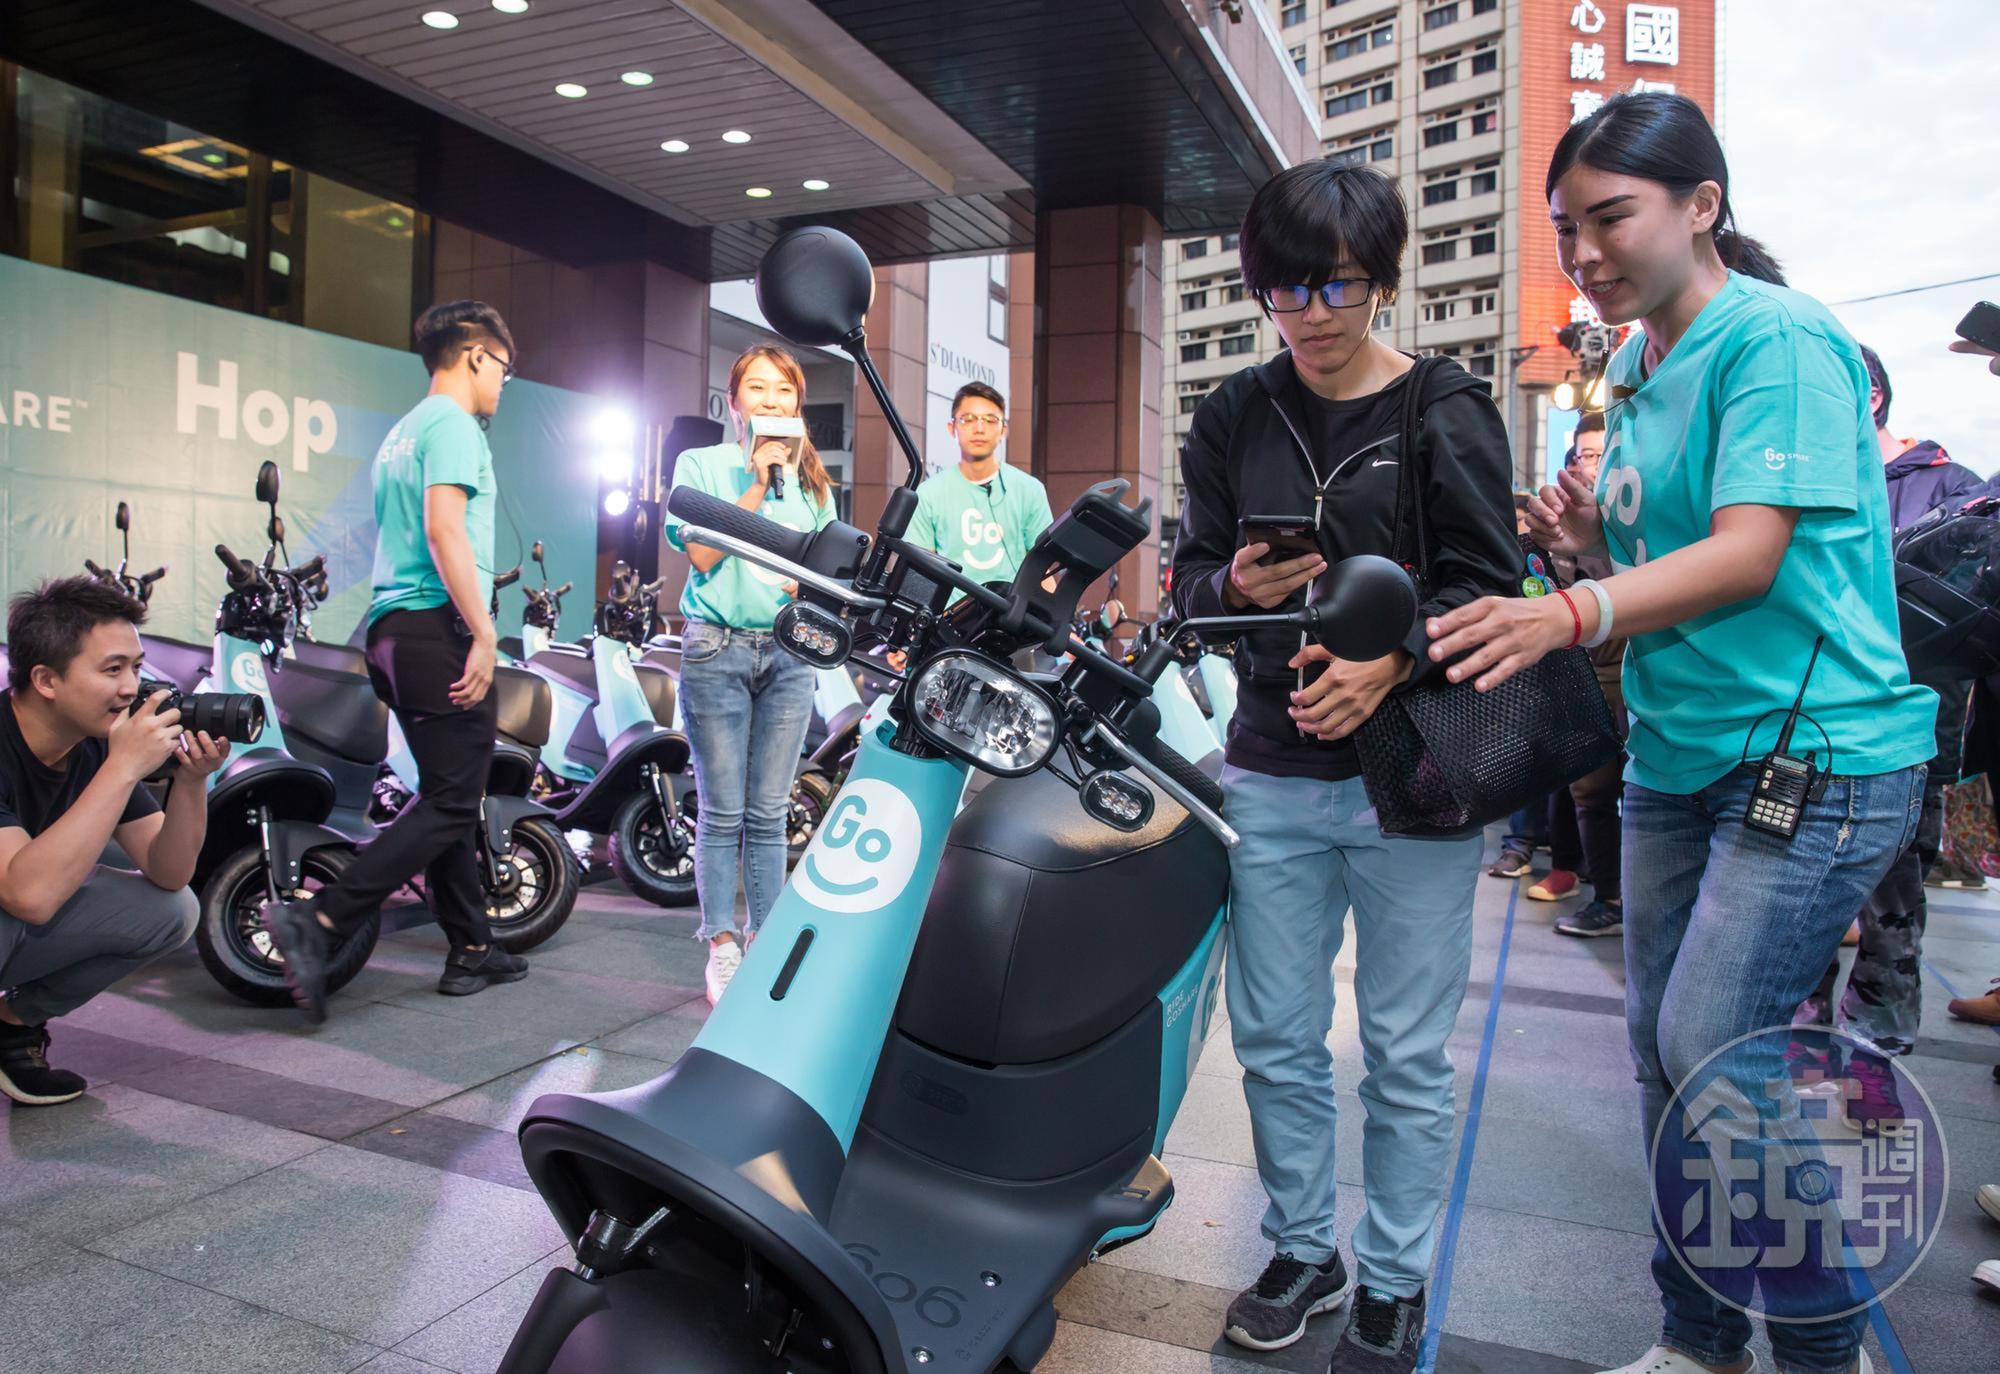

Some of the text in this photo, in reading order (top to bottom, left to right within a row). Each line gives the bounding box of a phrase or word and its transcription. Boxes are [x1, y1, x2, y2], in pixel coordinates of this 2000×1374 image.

[176, 351, 338, 473] Hop
[1764, 447, 1786, 462] Go
[960, 507, 1005, 546] Go
[822, 794, 892, 863] Go
[1167, 989, 1184, 1015] RIDE
